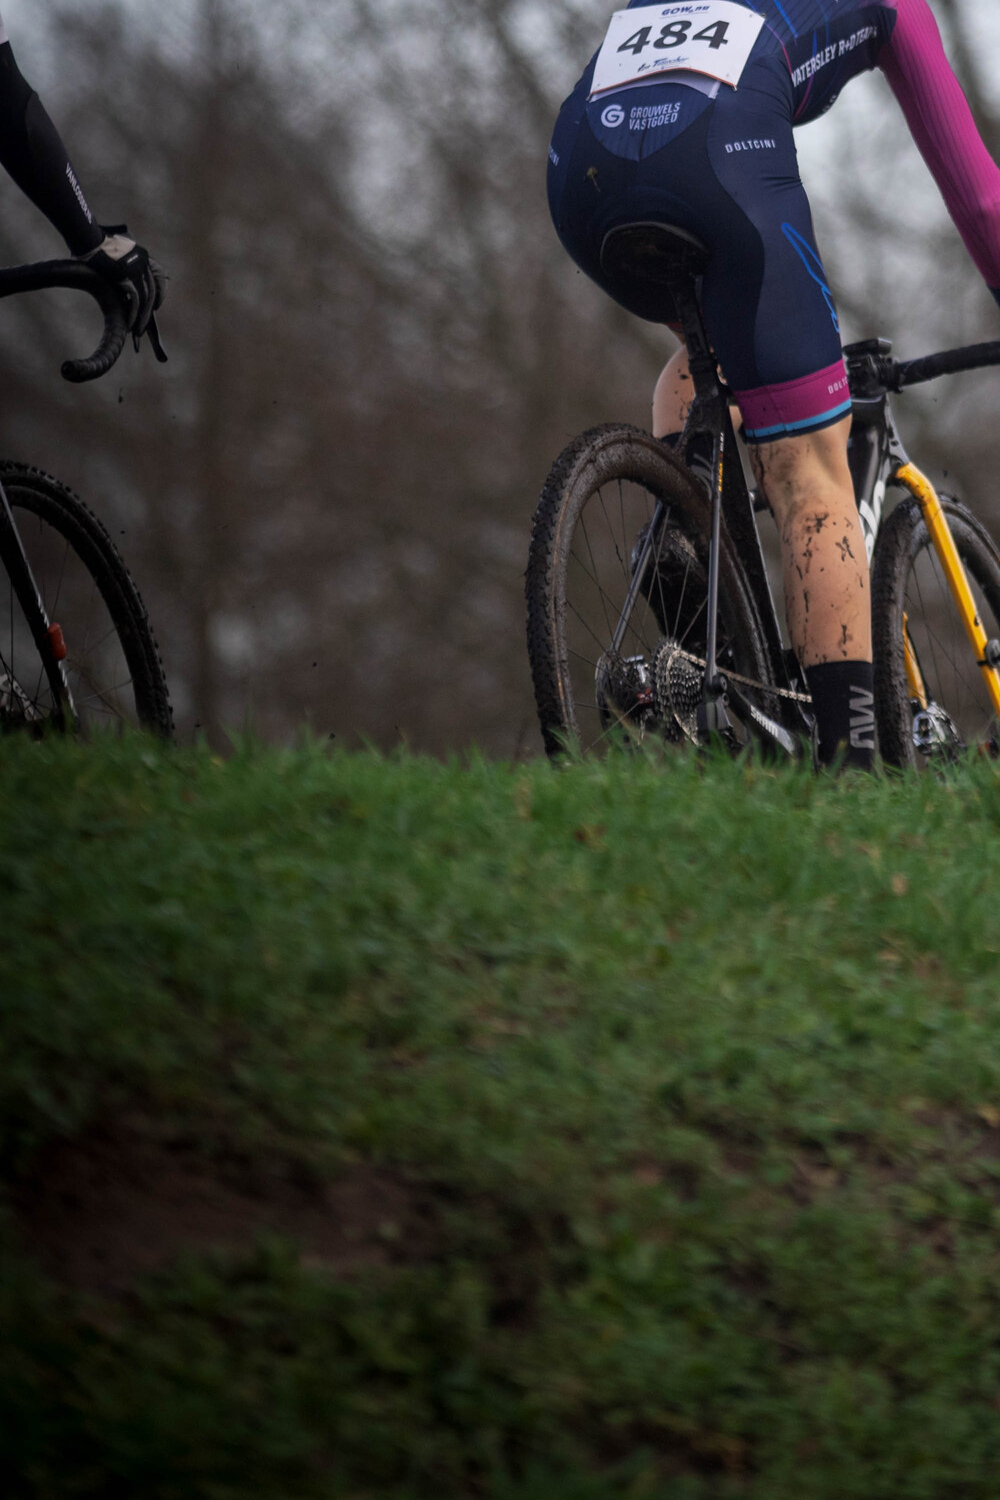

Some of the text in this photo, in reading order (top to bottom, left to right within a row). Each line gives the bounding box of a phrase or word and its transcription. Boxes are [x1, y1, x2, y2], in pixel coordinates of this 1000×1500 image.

[616, 20, 730, 55] 484
[630, 102, 681, 118] GROUWELS
[629, 112, 678, 130] VASTGOED
[725, 139, 776, 153] DOLTCINI
